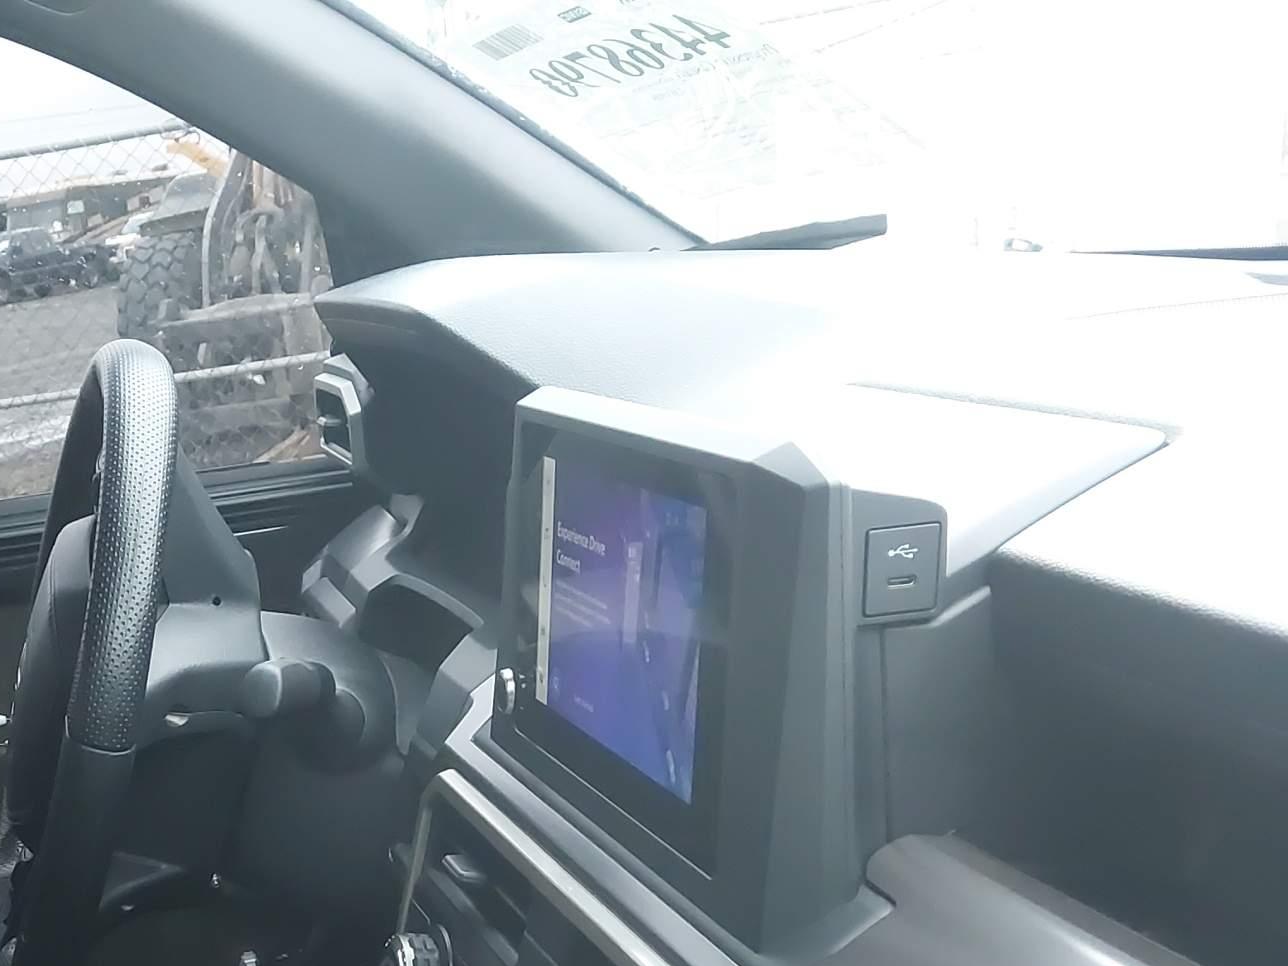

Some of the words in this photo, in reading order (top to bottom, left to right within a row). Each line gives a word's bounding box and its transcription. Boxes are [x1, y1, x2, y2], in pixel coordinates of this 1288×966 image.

[557, 520, 589, 550] Experience
[589, 535, 607, 557] Drive
[556, 549, 581, 575] Connect
